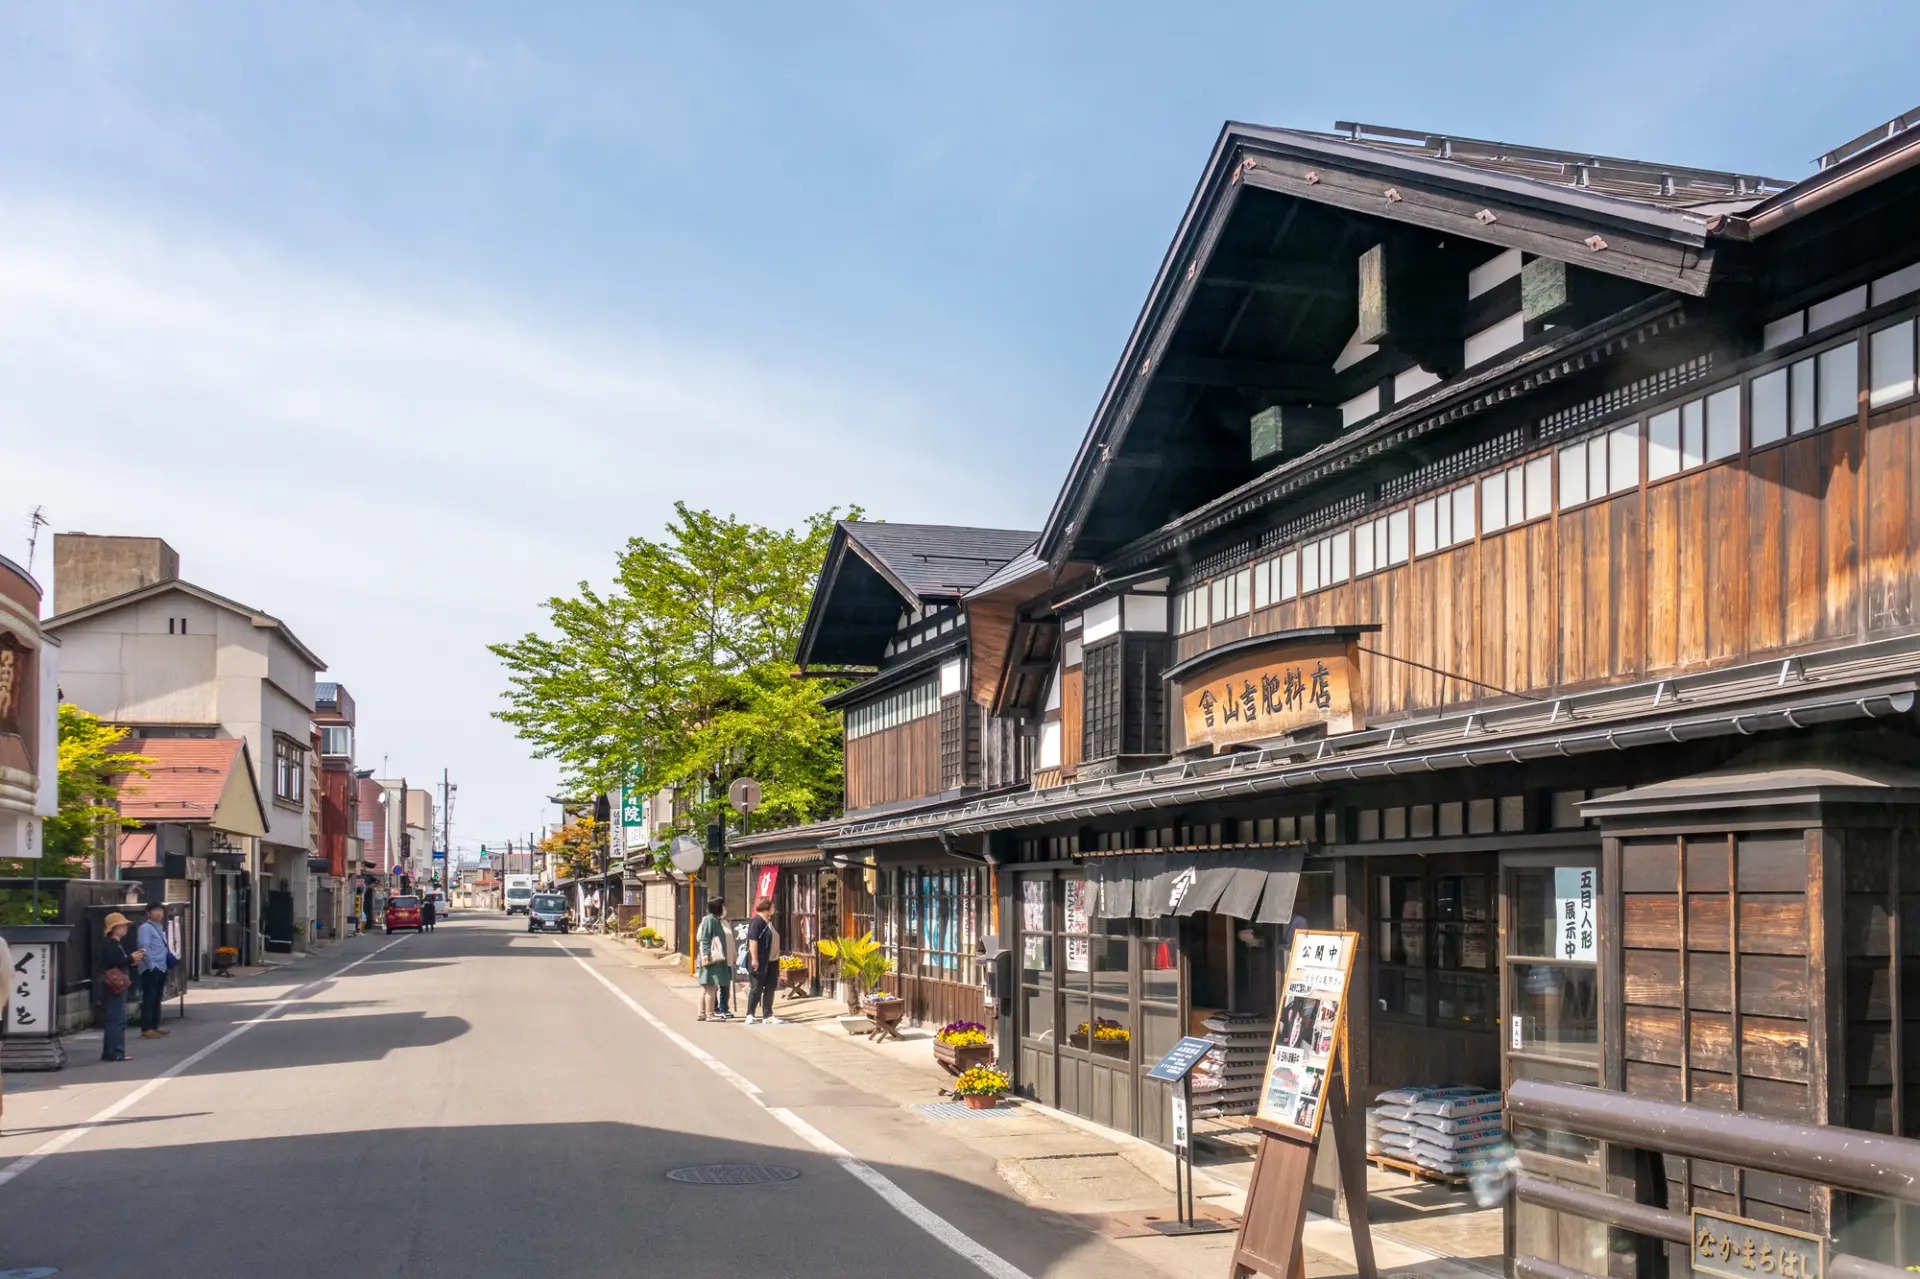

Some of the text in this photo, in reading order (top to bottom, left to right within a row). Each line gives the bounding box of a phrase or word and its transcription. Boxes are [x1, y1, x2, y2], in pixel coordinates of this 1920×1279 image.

[1565, 901, 1576, 959] 展示中
[1580, 870, 1593, 950] 五月人形
[1302, 945, 1338, 961] 公開中
[1697, 1226, 1816, 1279] なかまちはし
